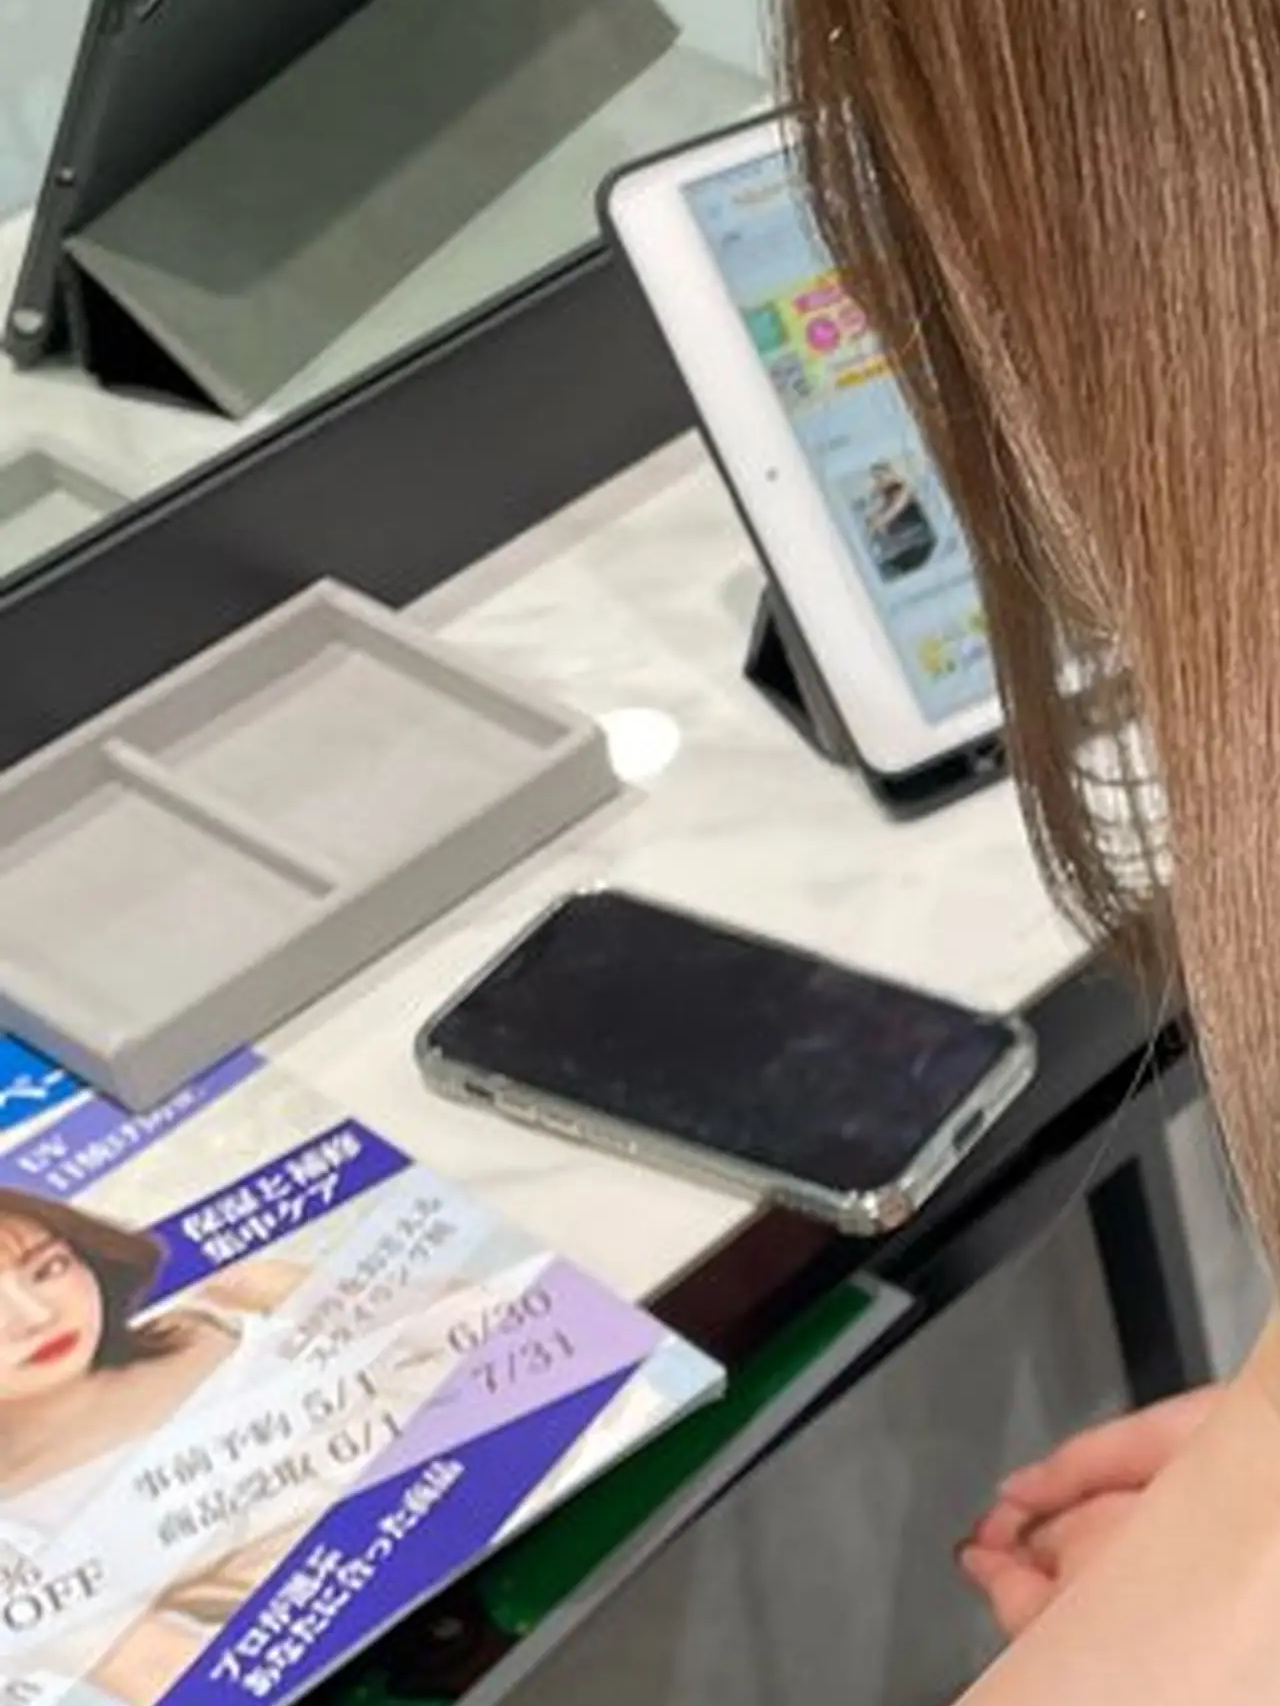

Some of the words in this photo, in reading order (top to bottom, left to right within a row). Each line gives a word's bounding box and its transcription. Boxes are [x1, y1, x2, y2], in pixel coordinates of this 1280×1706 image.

[302, 1369, 379, 1423] 5/1
[446, 1288, 554, 1356] 6/30
[326, 1411, 403, 1466] 6/1
[471, 1327, 577, 1397] 7/31
[3, 1556, 105, 1634] OFF
